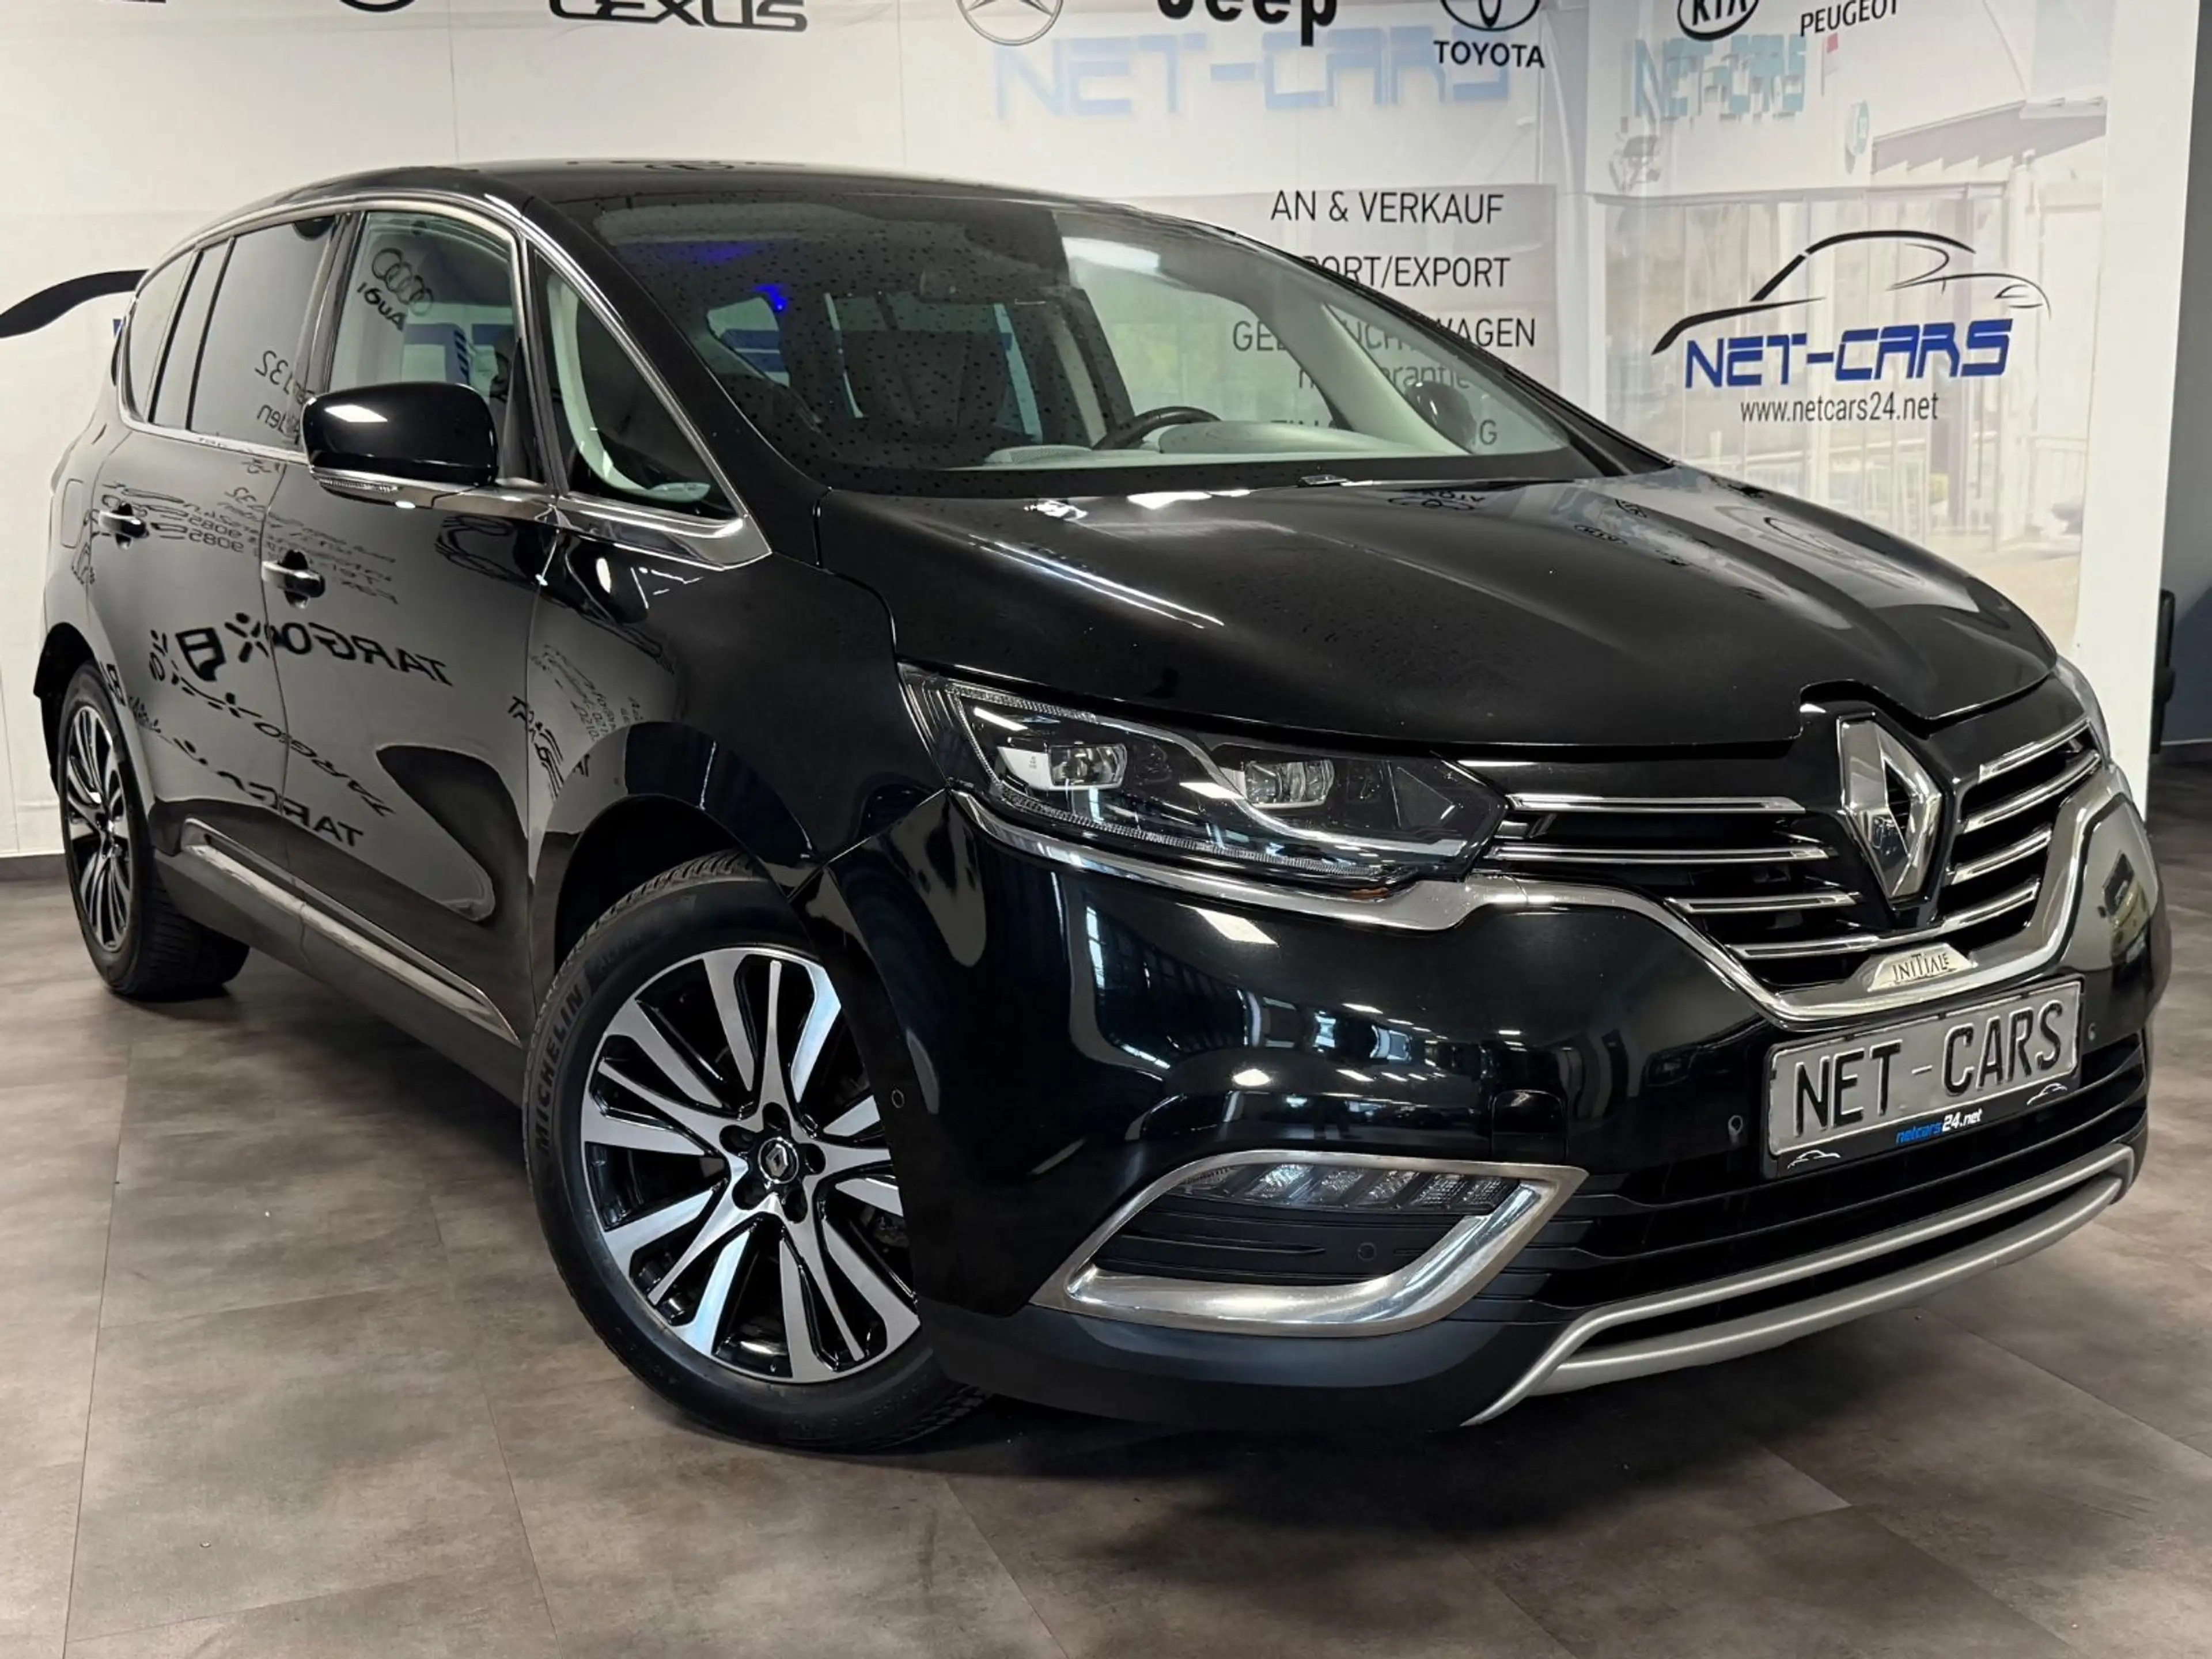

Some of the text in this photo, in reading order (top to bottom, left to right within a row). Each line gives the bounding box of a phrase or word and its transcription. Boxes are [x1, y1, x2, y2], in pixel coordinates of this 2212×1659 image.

[995, 25, 1510, 120] NET-CARS
[1433, 40, 1545, 69] TOYOTA
[1270, 190, 1504, 224] AN & VERKAUF
[1685, 318, 2013, 388] NET-CARS
[1740, 391, 1939, 422] www.netcars24.net
[1892, 952, 1950, 983] INITIALE
[535, 983, 584, 1152] MICHELIN
[1793, 1039, 1903, 1138] NET
[1942, 999, 2063, 1096] CARS
[1896, 1107, 1983, 1145] netcars24.net
